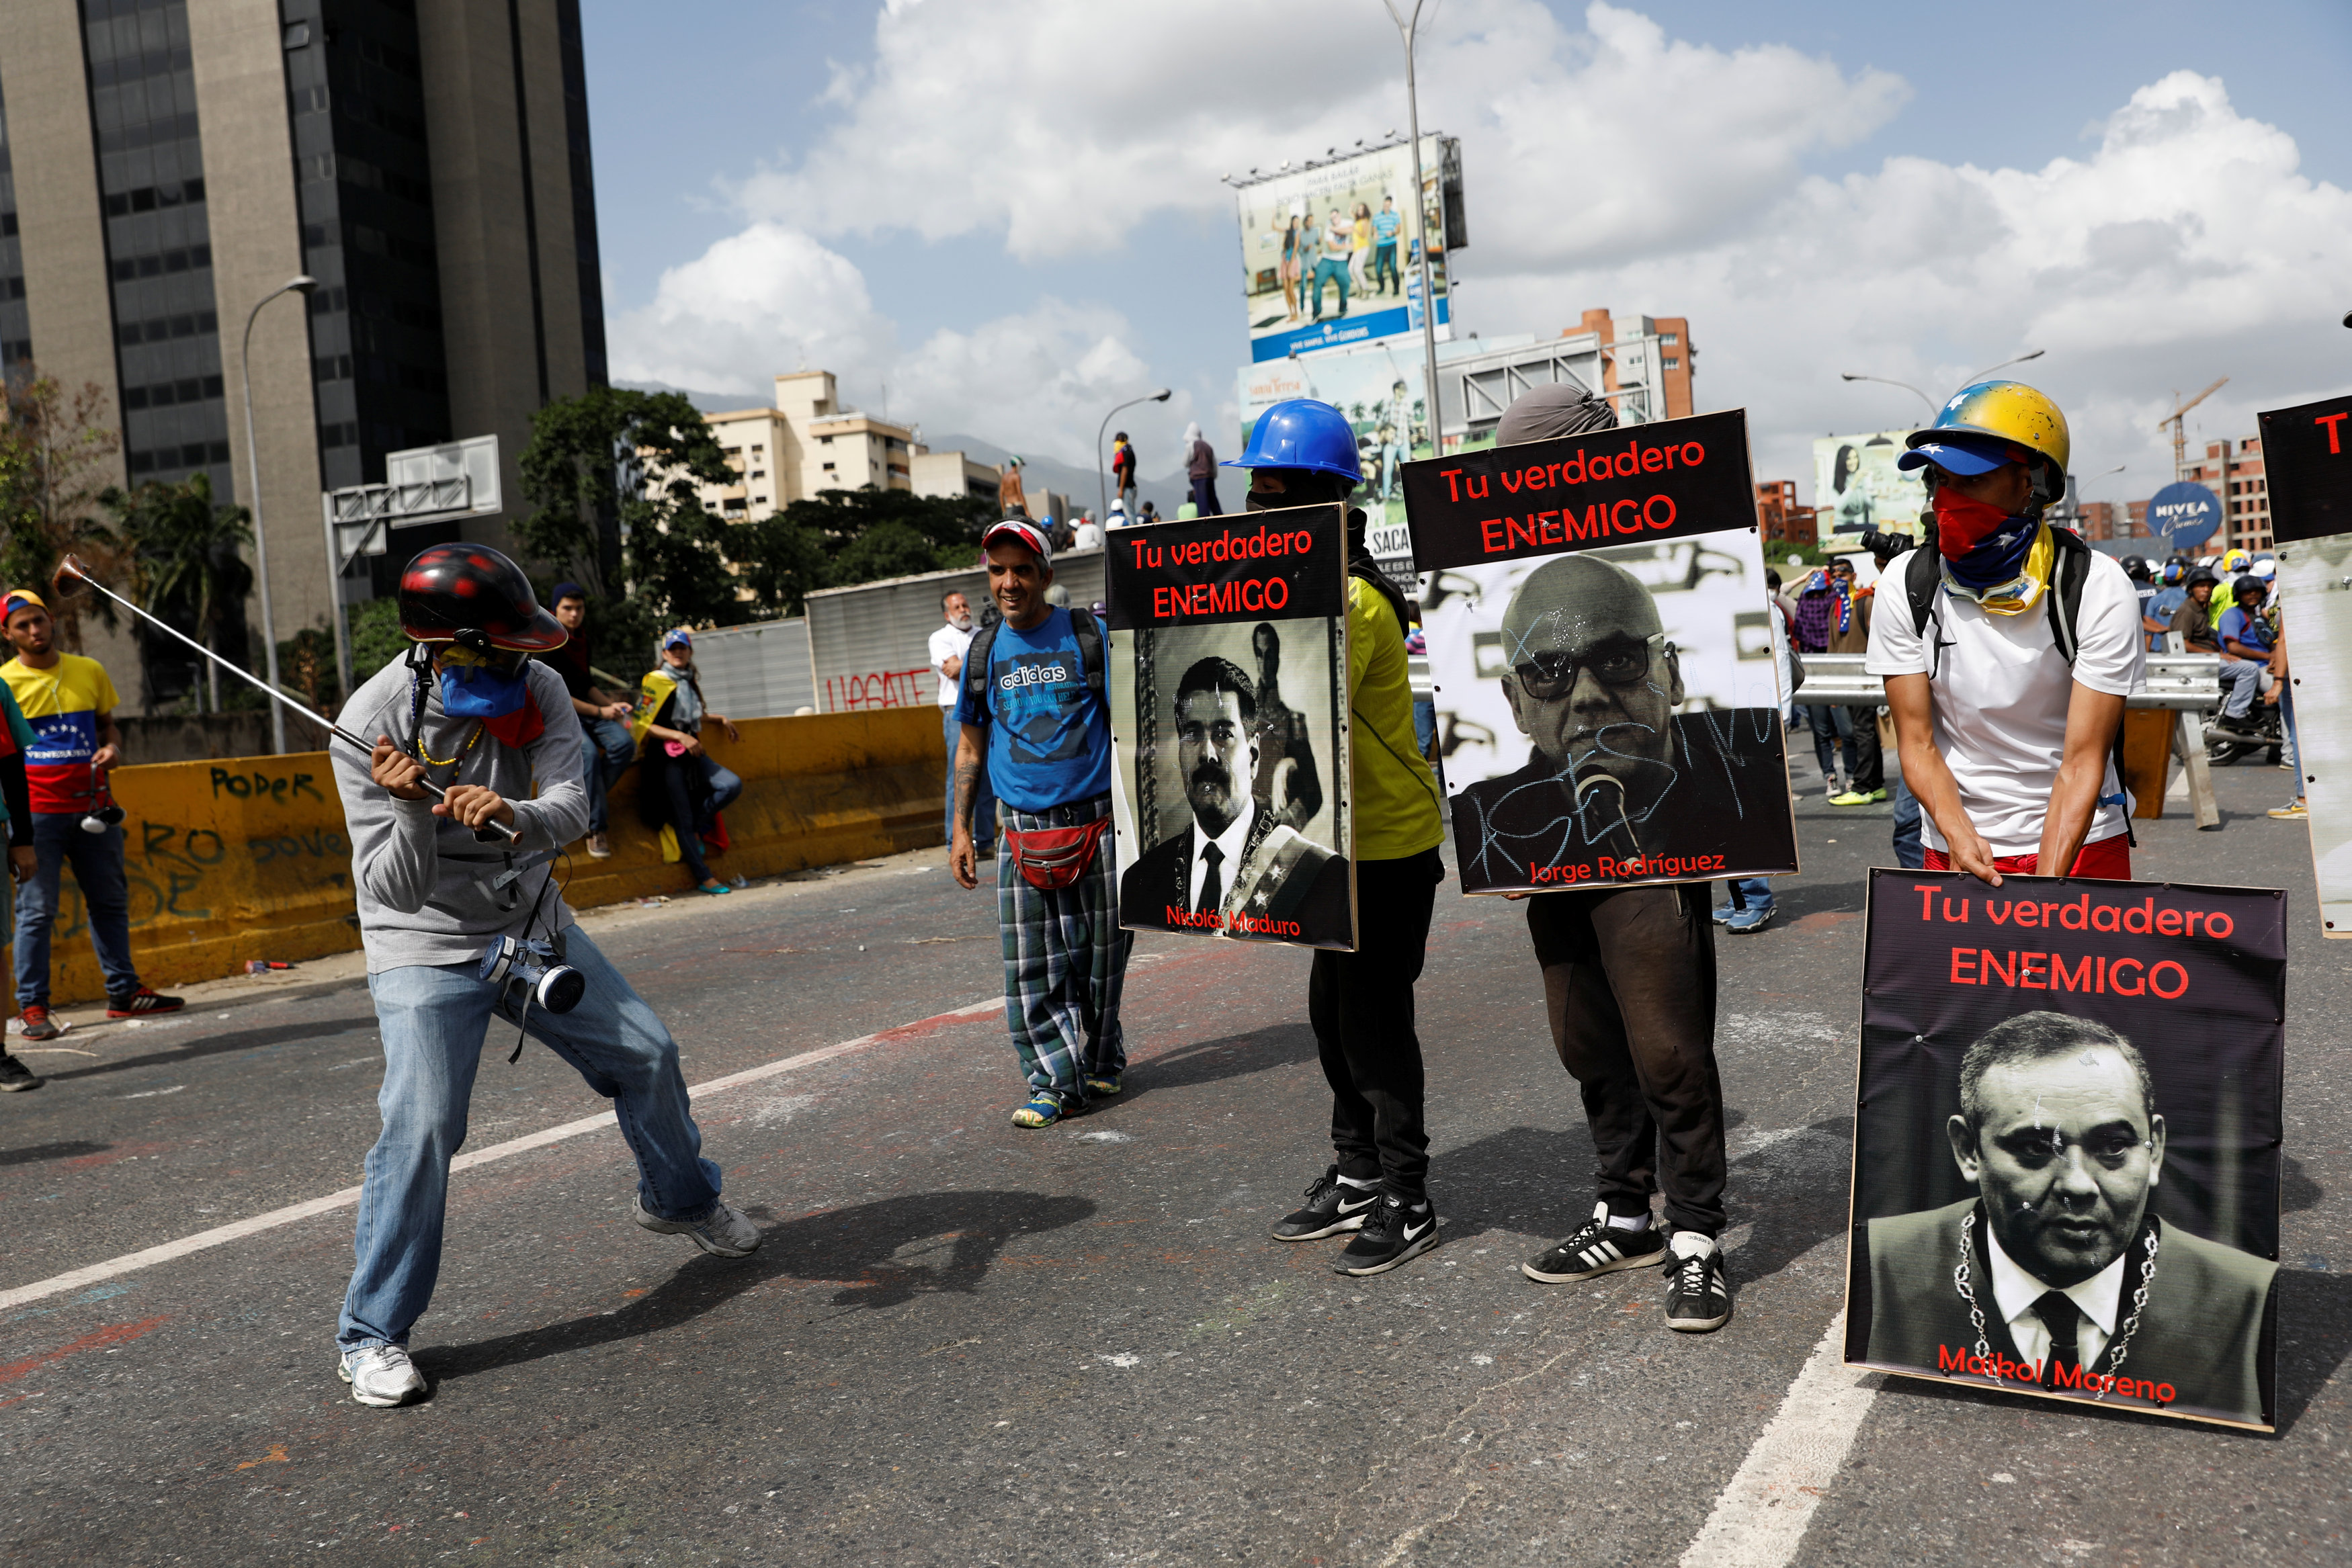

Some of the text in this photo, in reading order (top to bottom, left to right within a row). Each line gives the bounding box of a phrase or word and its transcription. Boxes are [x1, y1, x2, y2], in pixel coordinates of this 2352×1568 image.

[1441, 441, 1705, 503] Tu verdadero
[1480, 494, 1677, 553] ENEMIGO
[2156, 500, 2210, 517] NIVEA
[1131, 525, 1312, 569] Tu verdadero
[1373, 528, 1410, 554] SACA
[1154, 577, 1288, 617] ENEMIGO
[1001, 665, 1066, 690] adidas
[1030, 695, 1043, 705] YOU
[1043, 693, 1057, 703] CAN
[1531, 853, 1726, 884] Jorge Rodríguez
[1166, 905, 1300, 937] Nicolás Maduro
[1914, 885, 2234, 939] Tu verdadero
[1950, 947, 2189, 1000] ENEMIGO
[1687, 1235, 1707, 1244] adidas
[1938, 1344, 2176, 1403] Maikol Moreno
